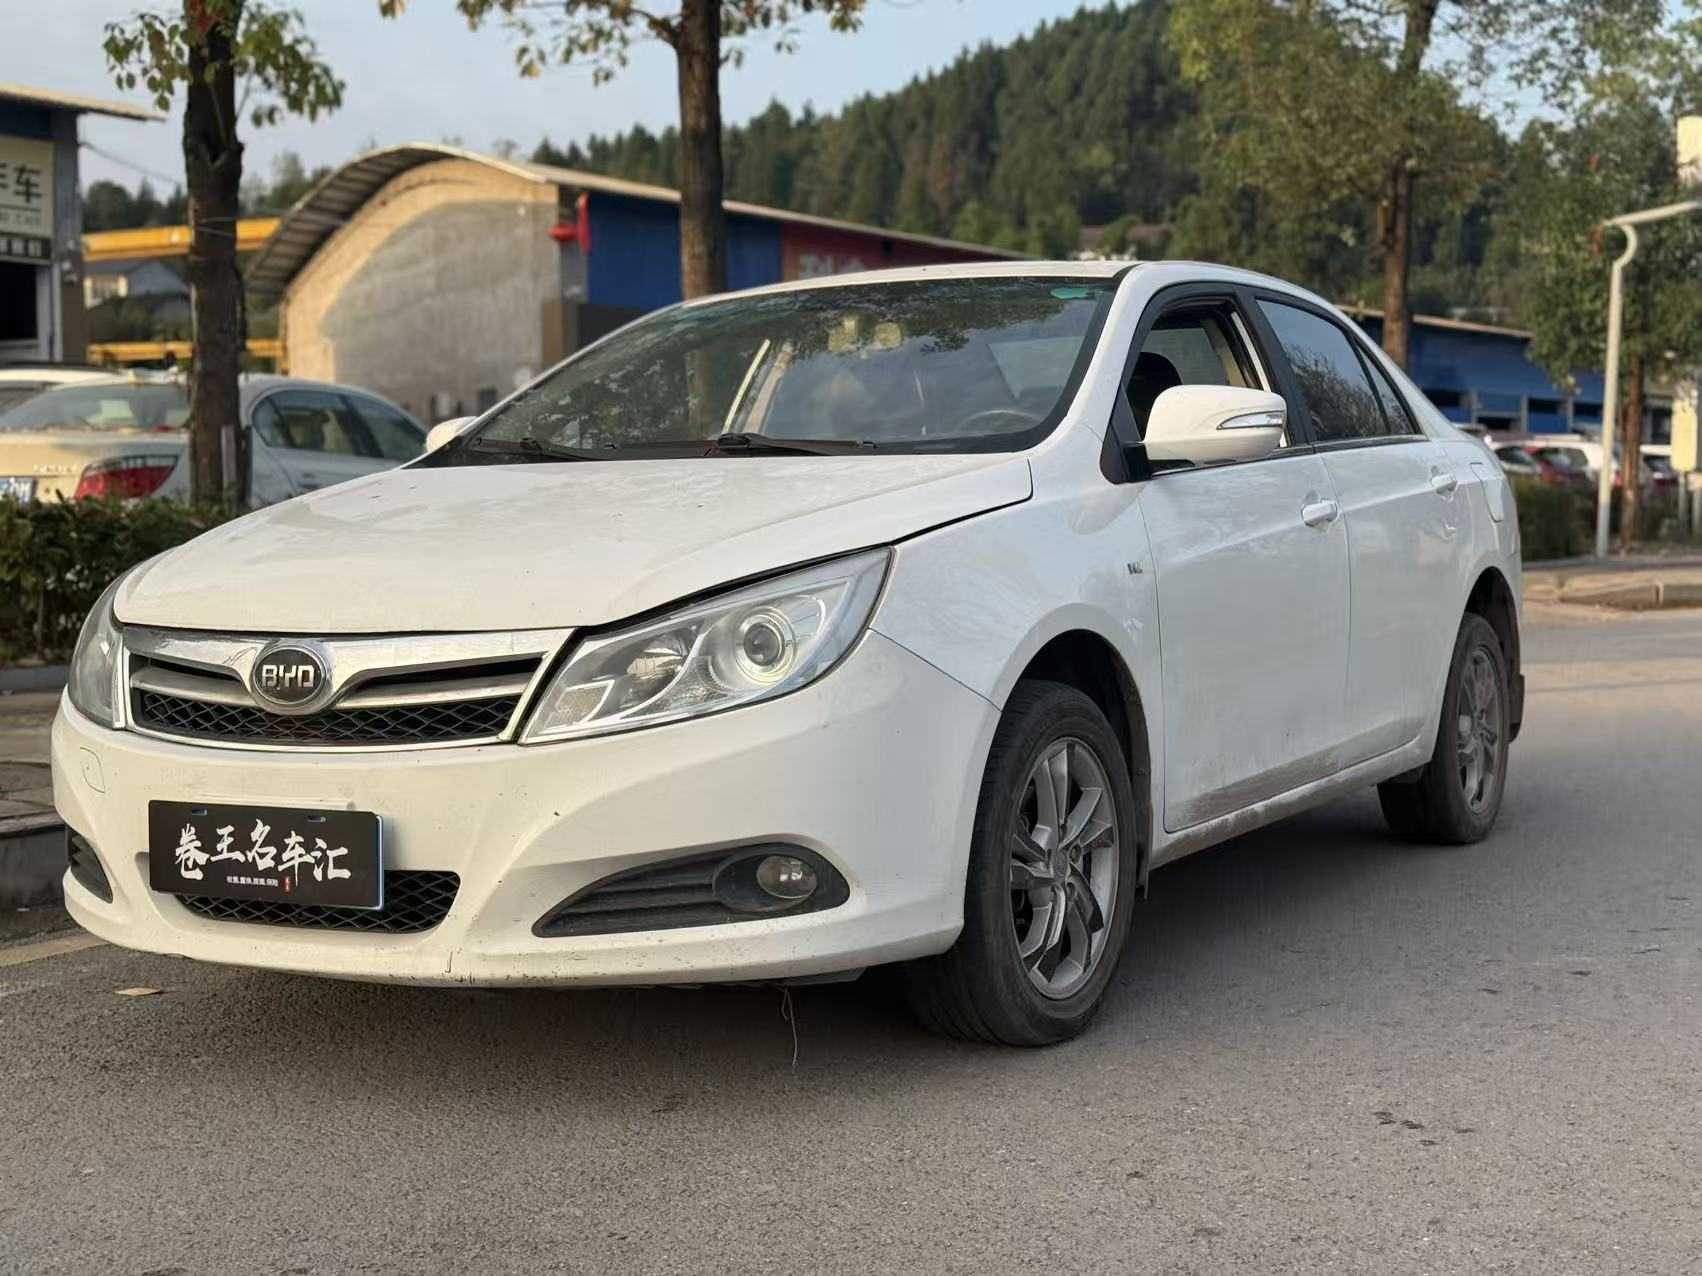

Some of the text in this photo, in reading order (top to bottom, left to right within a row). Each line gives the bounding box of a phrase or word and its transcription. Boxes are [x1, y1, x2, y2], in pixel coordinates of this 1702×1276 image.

[0, 164, 42, 203] 车
[262, 665, 314, 688] BYD
[175, 818, 351, 886] 卷王名车汇
